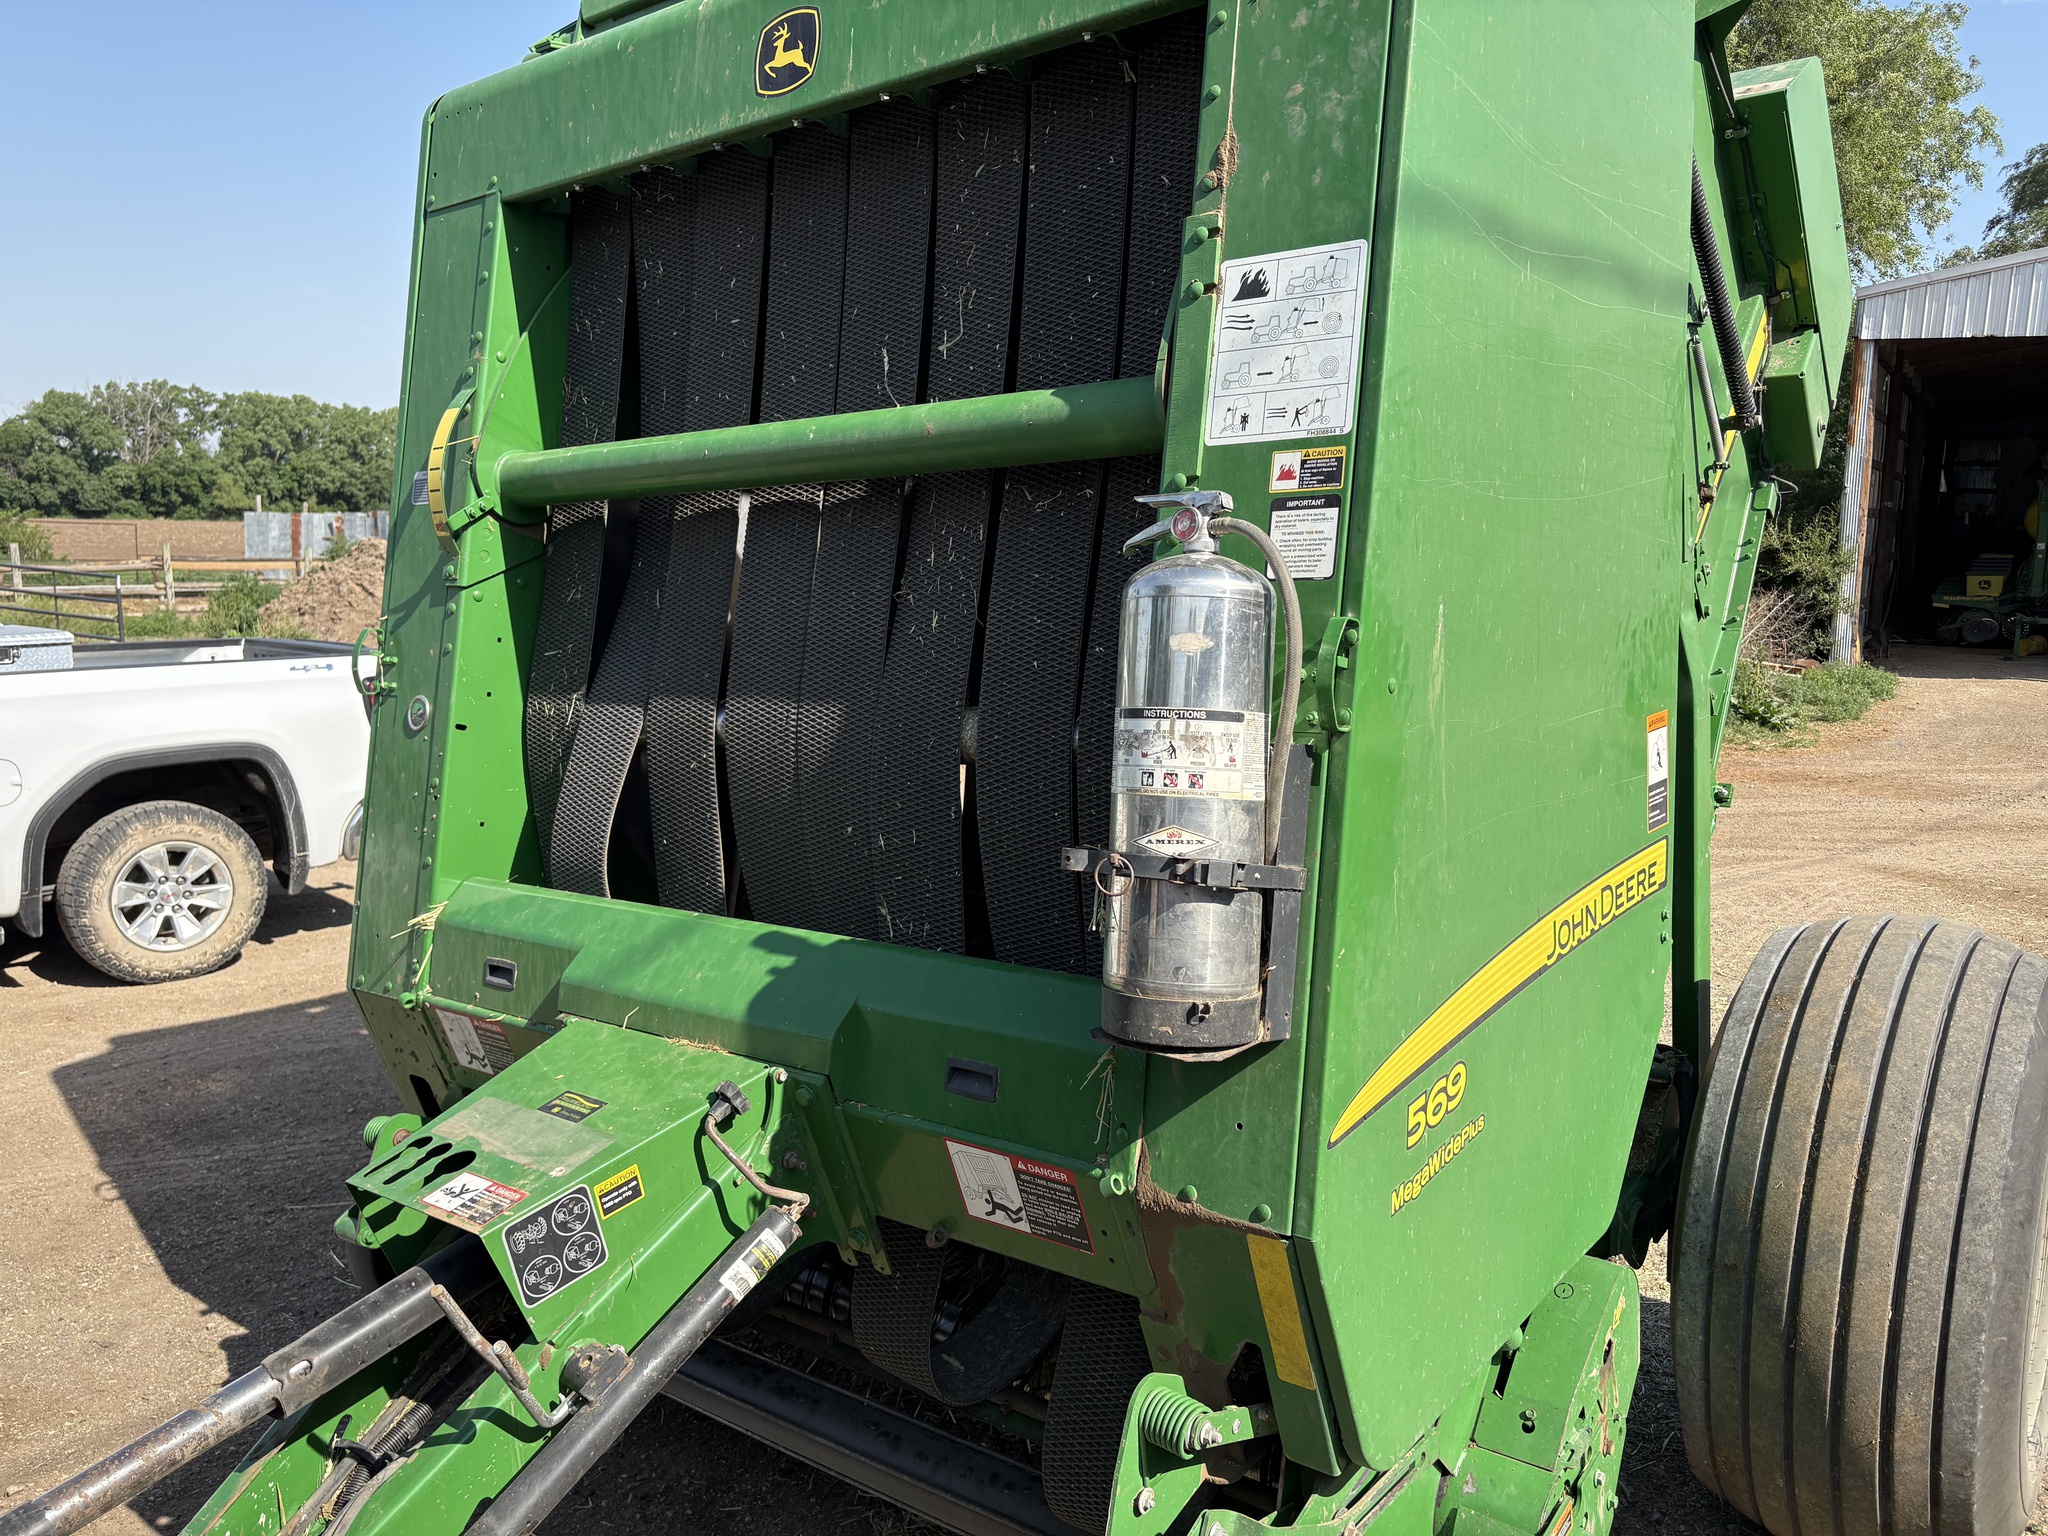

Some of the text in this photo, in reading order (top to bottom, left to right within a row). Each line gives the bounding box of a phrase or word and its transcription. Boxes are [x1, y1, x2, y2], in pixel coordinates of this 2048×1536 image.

[1312, 449, 1343, 457] CAUTION
[1286, 499, 1325, 507] IMPORTANT
[1143, 709, 1207, 718] INSTRUCTIONS
[1546, 860, 1658, 962] JOHN DEERE
[1407, 1060, 1467, 1150] 569
[1391, 1114, 1486, 1218] MegaWidePlus
[1027, 1164, 1068, 1181] DANGER
[603, 1169, 636, 1190] CAUTION
[1035, 1177, 1047, 1185] TAKE
[1037, 1184, 1049, 1192] injury
[495, 1187, 521, 1200] DANGER
[601, 1191, 618, 1202] Operate
[603, 1201, 614, 1209] 1000
[1066, 1209, 1081, 1218] unplug
[1031, 1224, 1052, 1233] Disengage
